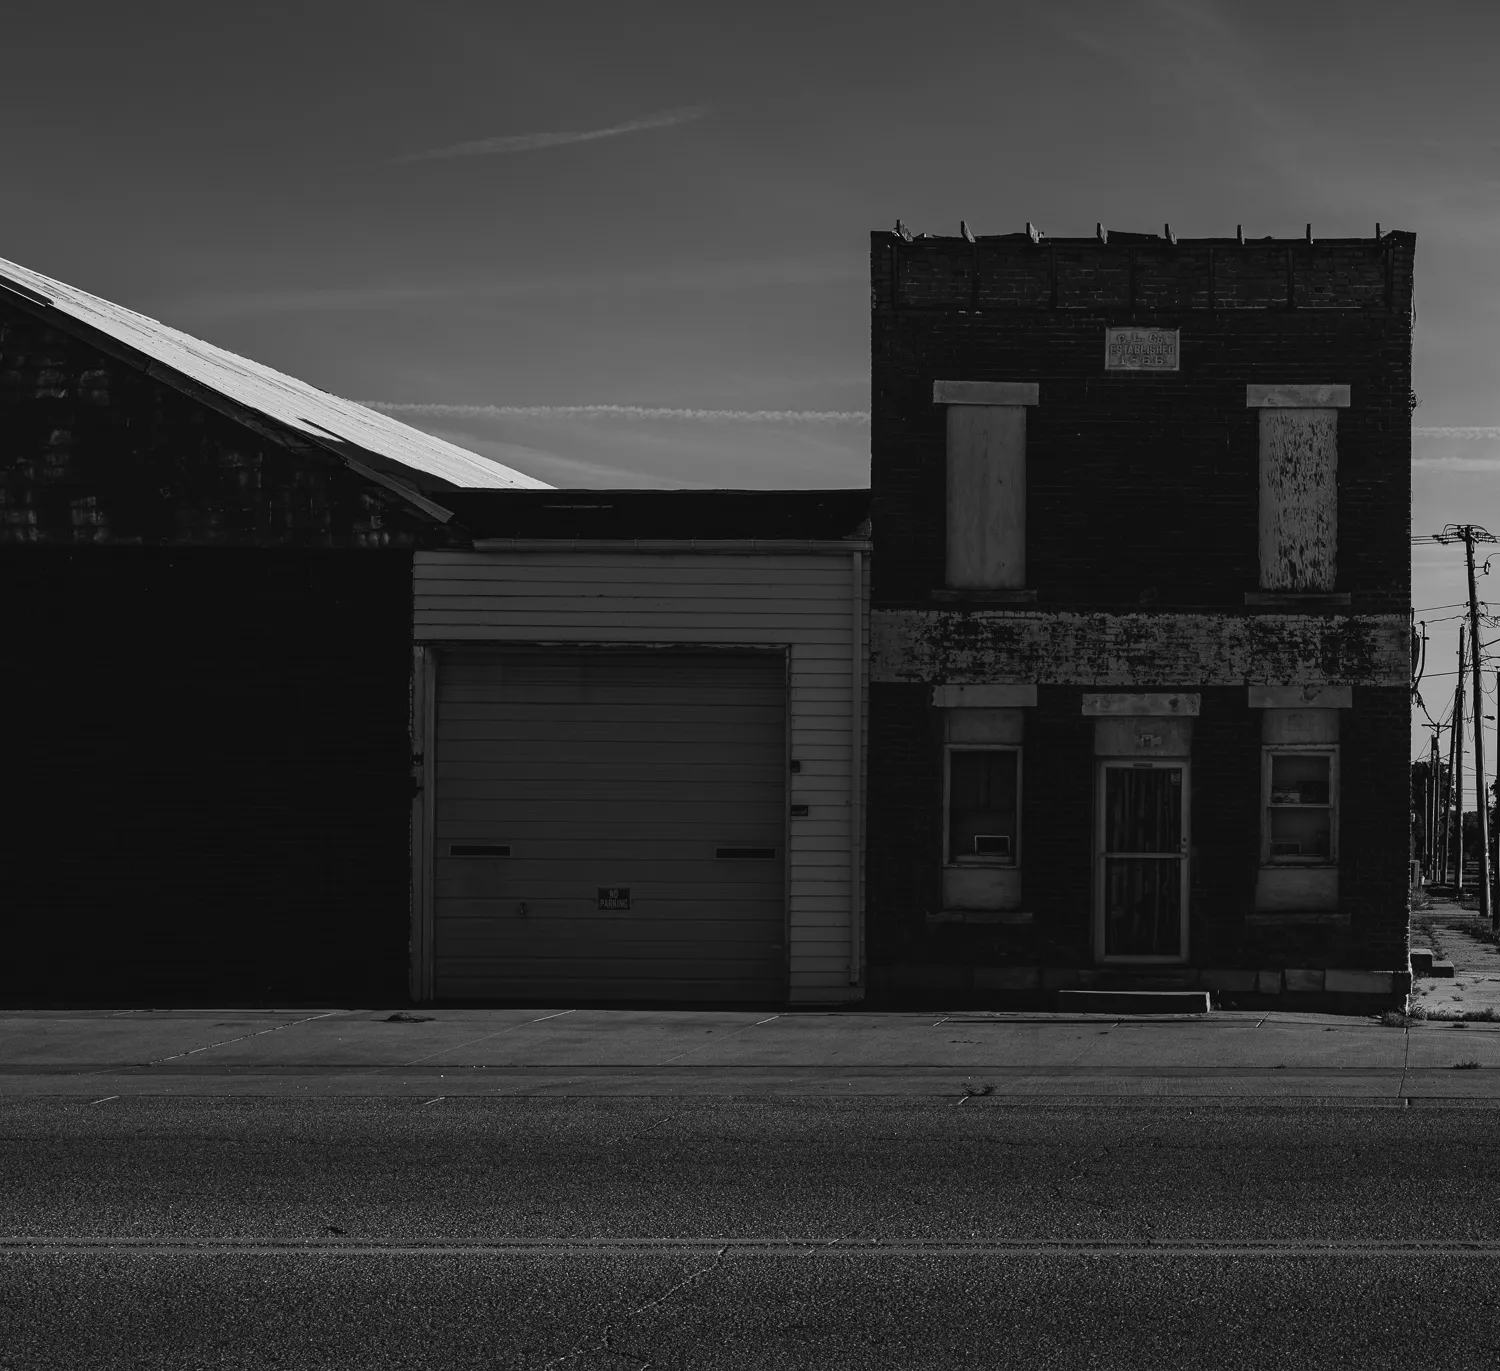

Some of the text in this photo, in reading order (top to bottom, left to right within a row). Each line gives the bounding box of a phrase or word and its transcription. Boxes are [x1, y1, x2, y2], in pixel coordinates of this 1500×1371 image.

[1110, 344, 1174, 354] ESTABLISHED
[609, 889, 619, 899] NO
[600, 899, 628, 909] PARKING
